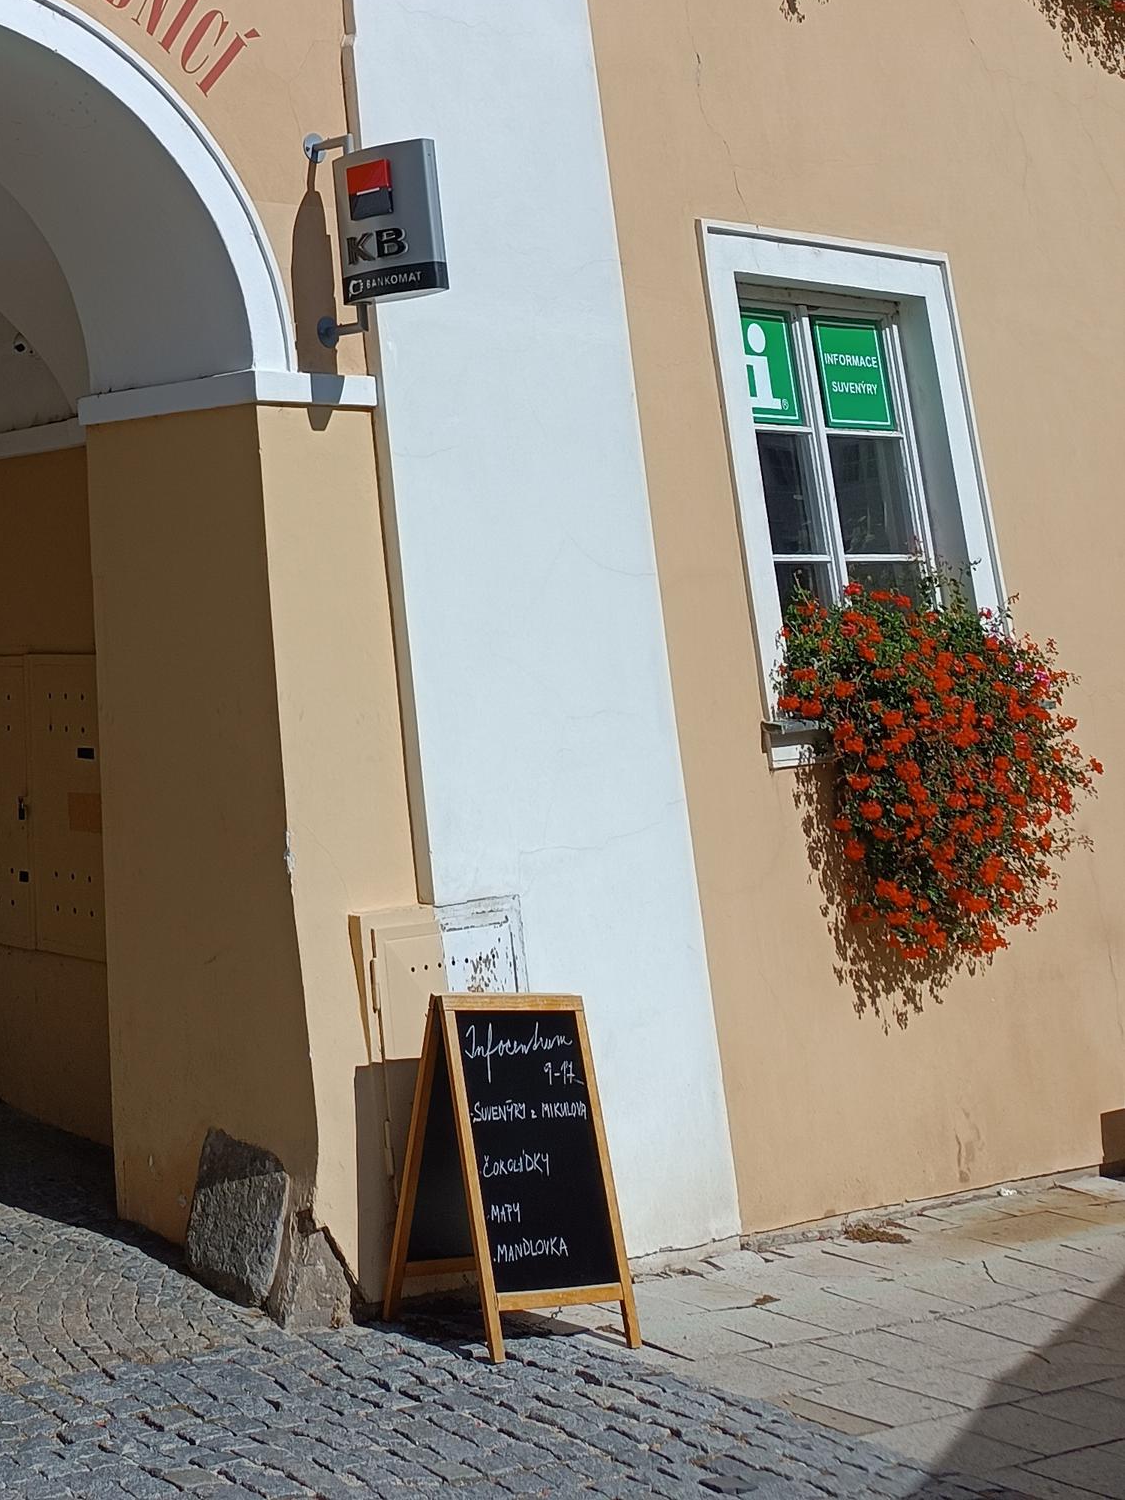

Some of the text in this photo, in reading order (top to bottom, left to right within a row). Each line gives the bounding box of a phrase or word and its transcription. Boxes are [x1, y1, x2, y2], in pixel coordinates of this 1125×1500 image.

[346, 227, 409, 266] KB
[366, 271, 422, 289] BANKOMAT
[824, 353, 878, 368] INFORMACE
[831, 381, 878, 396] SUVENÝRY
[464, 1021, 573, 1084] Infocentrum
[541, 1101, 587, 1120] MIKULOVA
[491, 1202, 521, 1223] MAPY
[497, 1236, 569, 1263] MANDLOVKA
